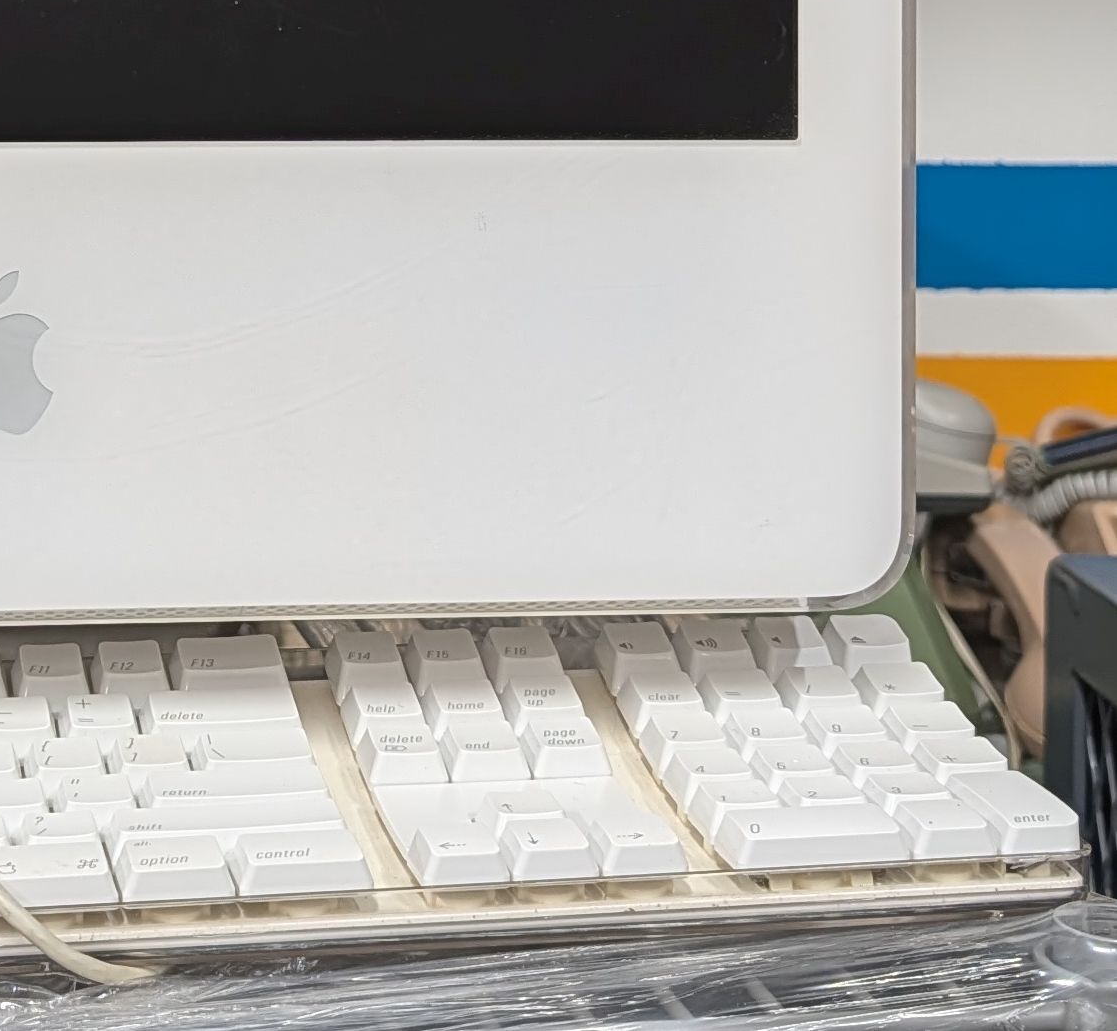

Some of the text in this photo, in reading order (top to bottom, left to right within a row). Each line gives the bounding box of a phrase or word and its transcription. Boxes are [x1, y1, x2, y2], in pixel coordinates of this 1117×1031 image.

[347, 651, 371, 660] F14
[426, 650, 449, 659] F15
[504, 646, 527, 656] F16
[109, 661, 135, 670] F12
[190, 658, 215, 667] F13
[28, 665, 50, 674] F11
[523, 688, 556, 697] page
[647, 692, 680, 701] clear
[75, 698, 91, 709] +
[447, 701, 485, 710] home
[527, 699, 544, 707] up
[366, 703, 396, 714] help
[160, 711, 205, 720] delete
[751, 727, 761, 736] 8
[832, 724, 842, 733] 9
[543, 729, 576, 738] page
[670, 730, 679, 739] 7
[379, 734, 423, 744] delete
[547, 737, 585, 746] down
[465, 741, 490, 750] end
[776, 761, 786, 770] 5
[860, 757, 869, 766] 6
[695, 764, 705, 773] 4
[162, 788, 208, 796] return
[807, 790, 817, 798] 2
[892, 786, 902, 794] 3
[35, 816, 44, 825] ?
[1014, 813, 1051, 823] enter
[129, 823, 163, 831] shift
[750, 823, 760, 834] 0
[256, 847, 311, 860] control
[139, 855, 189, 867] option
